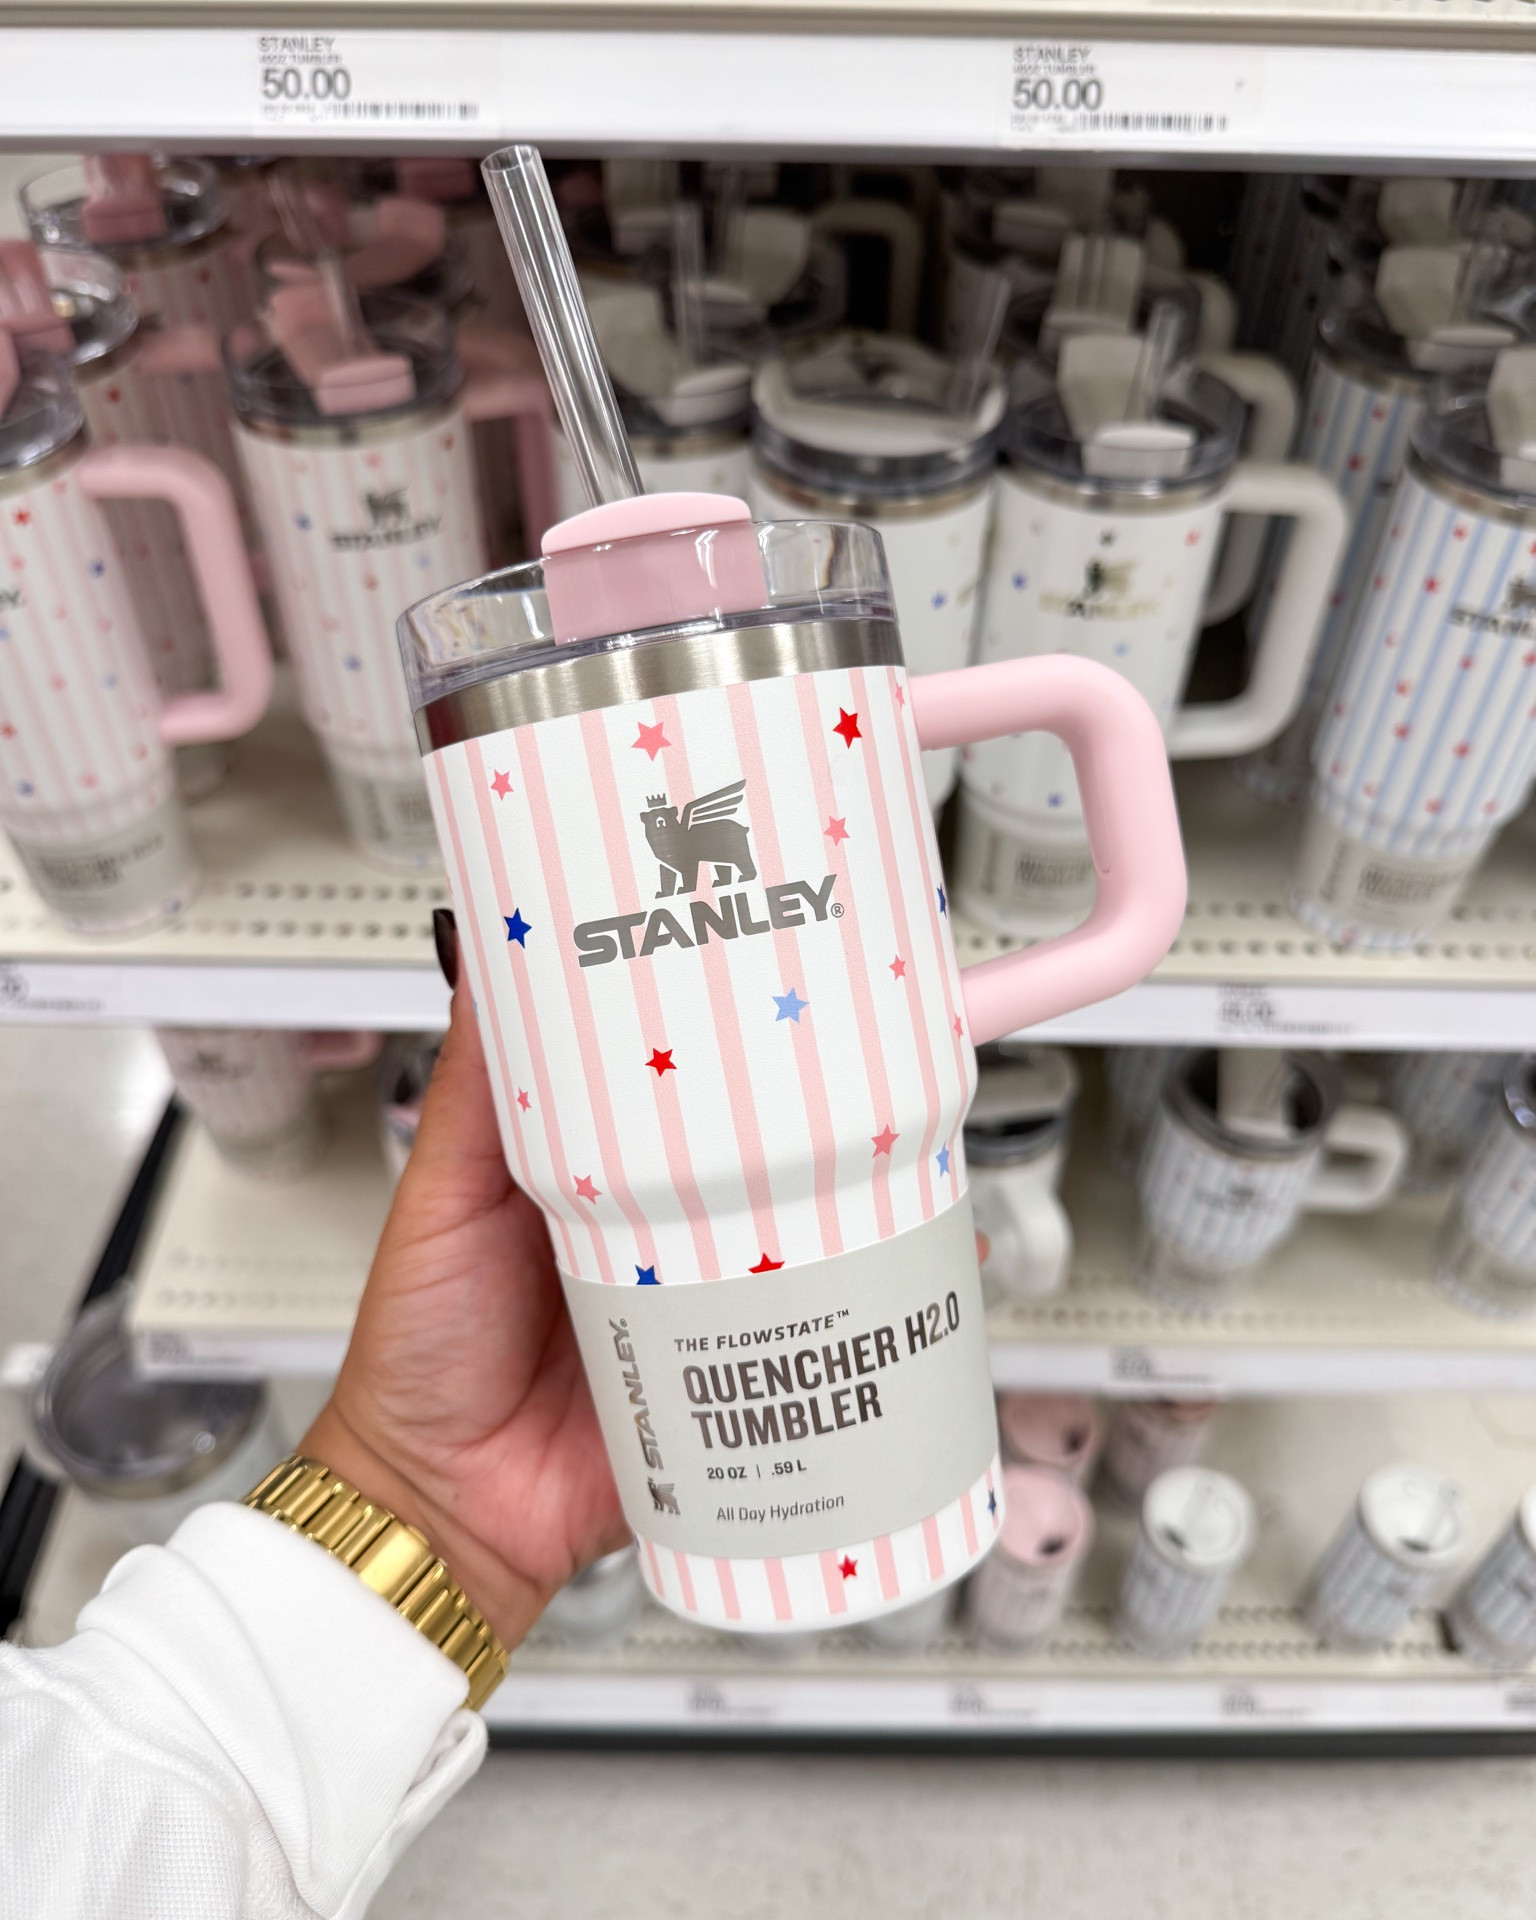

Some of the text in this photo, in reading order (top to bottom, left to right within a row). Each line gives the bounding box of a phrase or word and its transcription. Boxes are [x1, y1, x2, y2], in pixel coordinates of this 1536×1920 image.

[258, 36, 336, 53] STANLEY
[1013, 47, 1093, 63] STANLEY
[262, 68, 352, 100] 50.00
[1013, 78, 1103, 110] 50.00
[674, 1336, 709, 1353] THE
[682, 1290, 961, 1405] QUENCHER H2.0
[690, 1380, 883, 1450] TUMBLER
[706, 1466, 725, 1480] 20
[727, 1466, 748, 1480] OZ
[770, 1460, 794, 1476] .59
[796, 1458, 808, 1472] L
[716, 1495, 845, 1523] All Day Hydration
